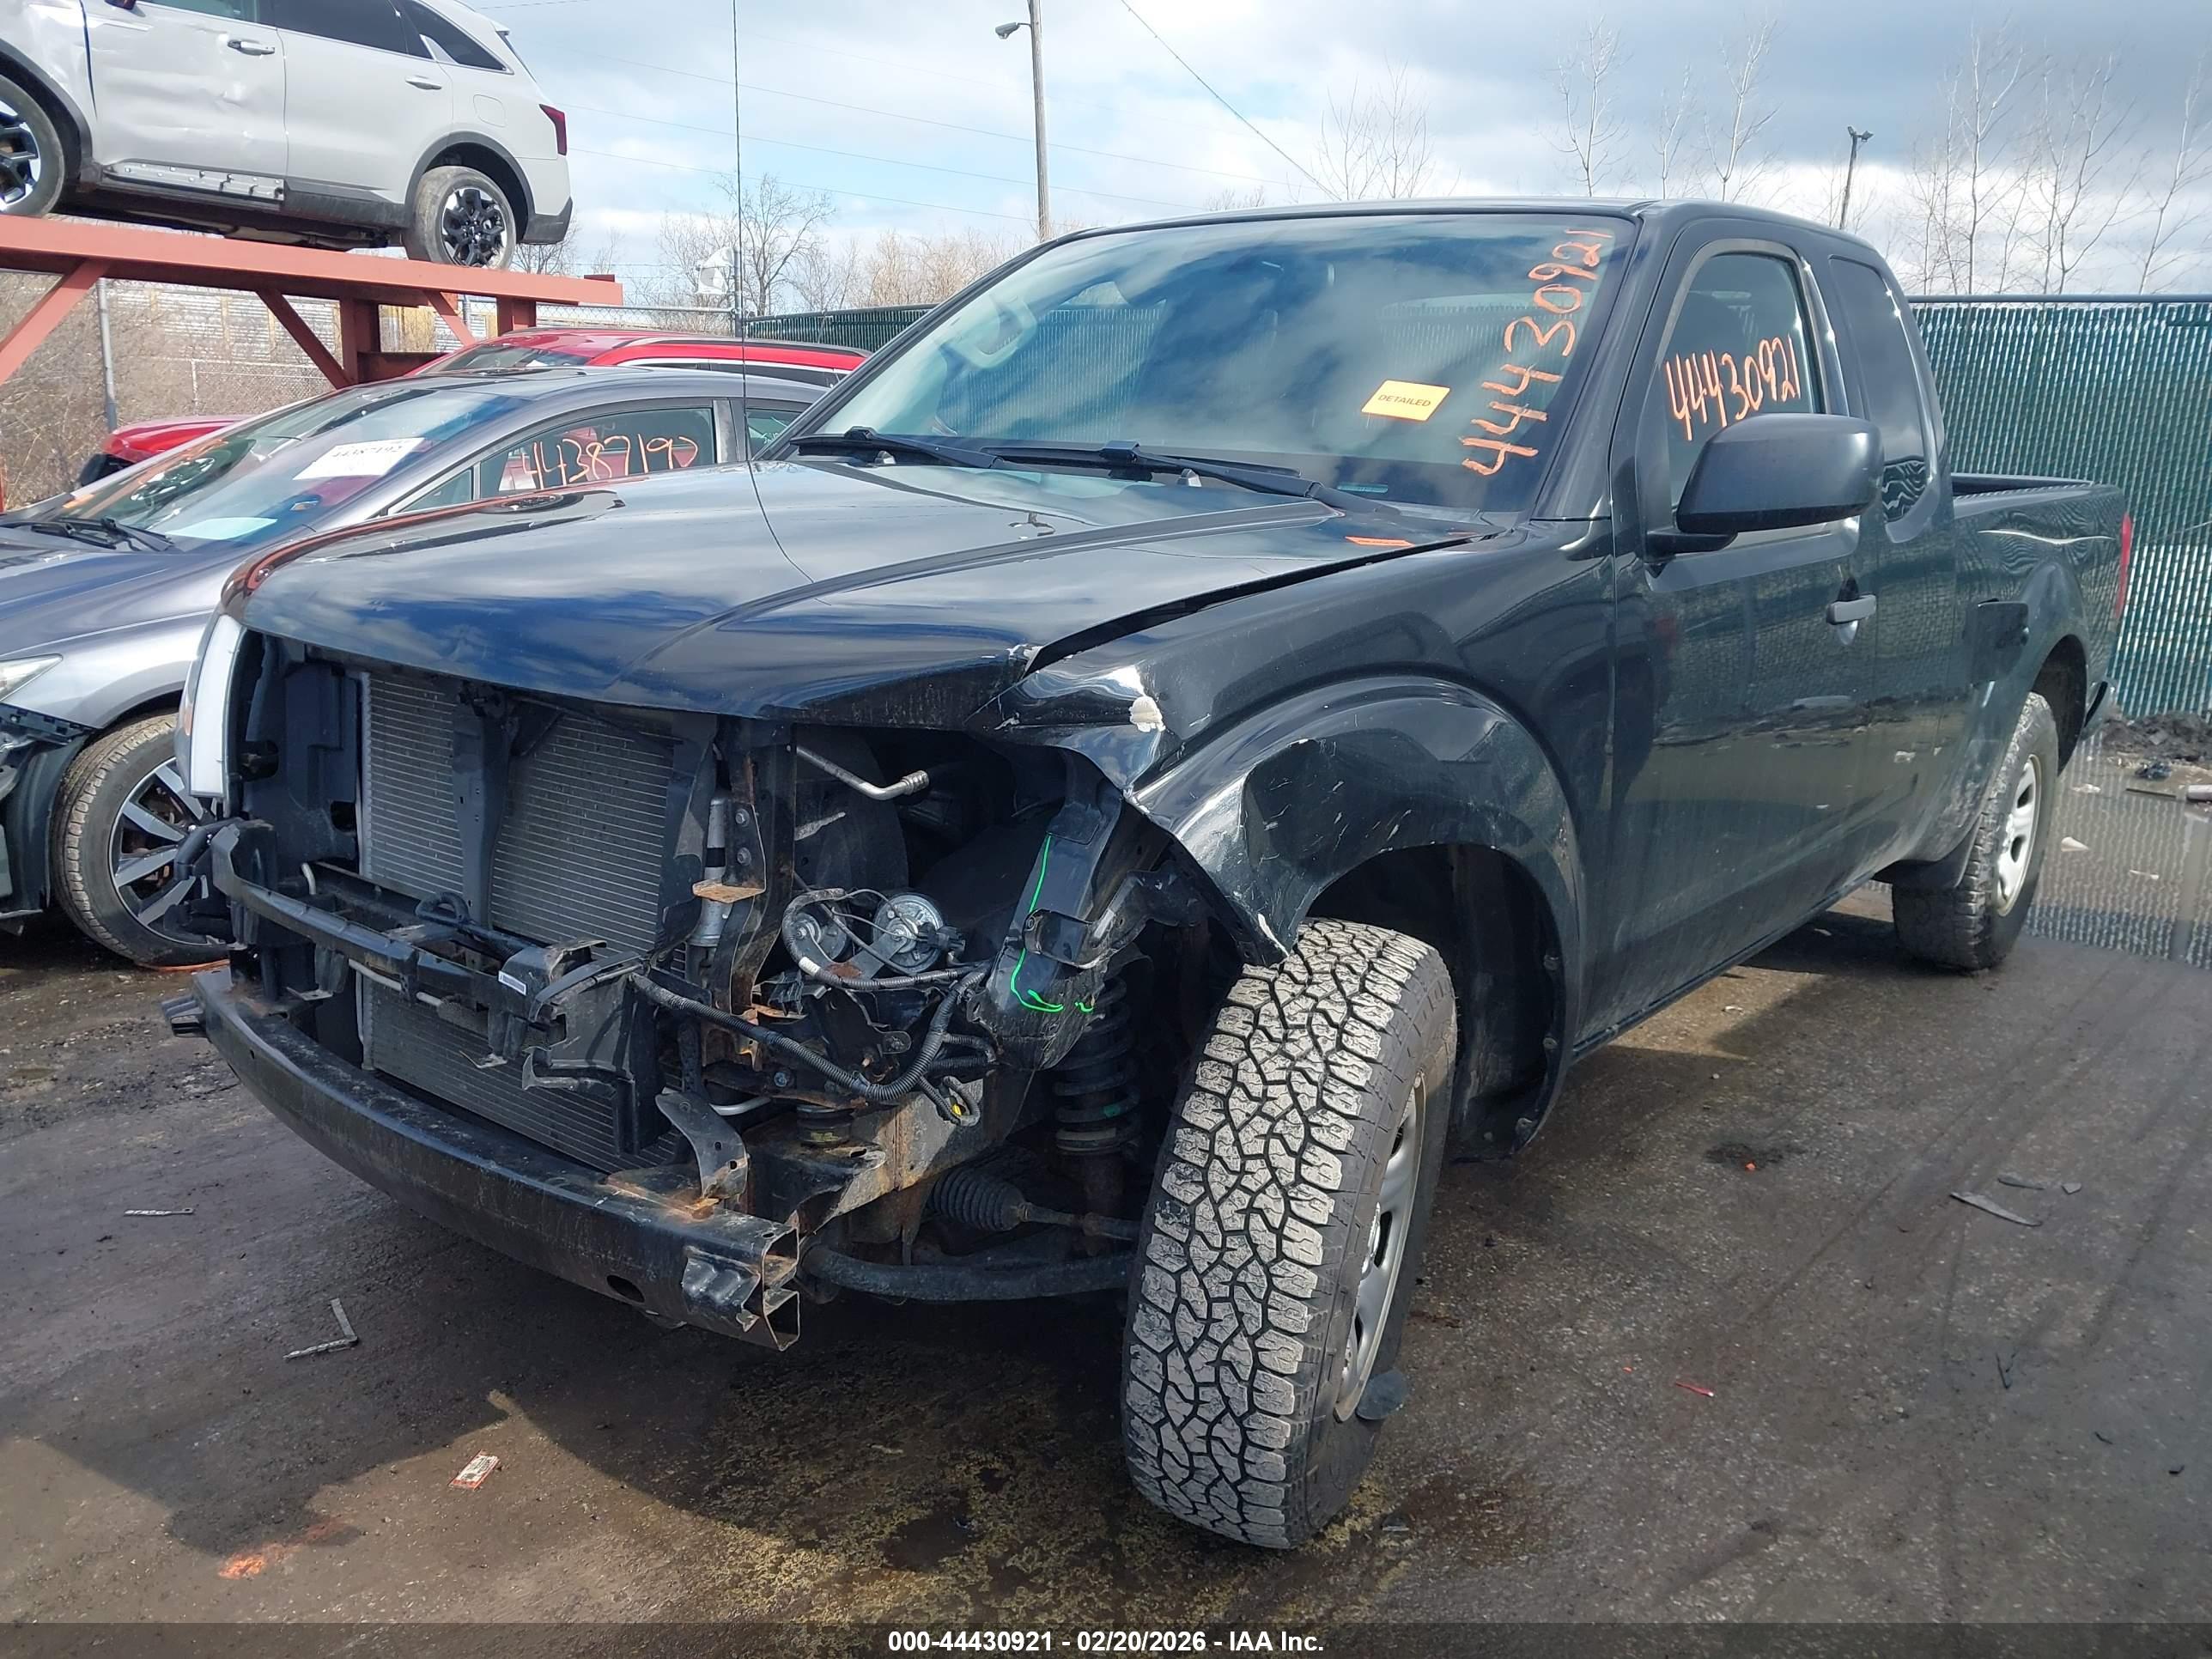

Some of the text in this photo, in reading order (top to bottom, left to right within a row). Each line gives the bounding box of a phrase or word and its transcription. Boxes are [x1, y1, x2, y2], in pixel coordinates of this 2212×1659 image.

[1376, 393, 1432, 408] DETAILED
[1459, 228, 1613, 476] 44430921
[1665, 331, 1802, 441] 44430921
